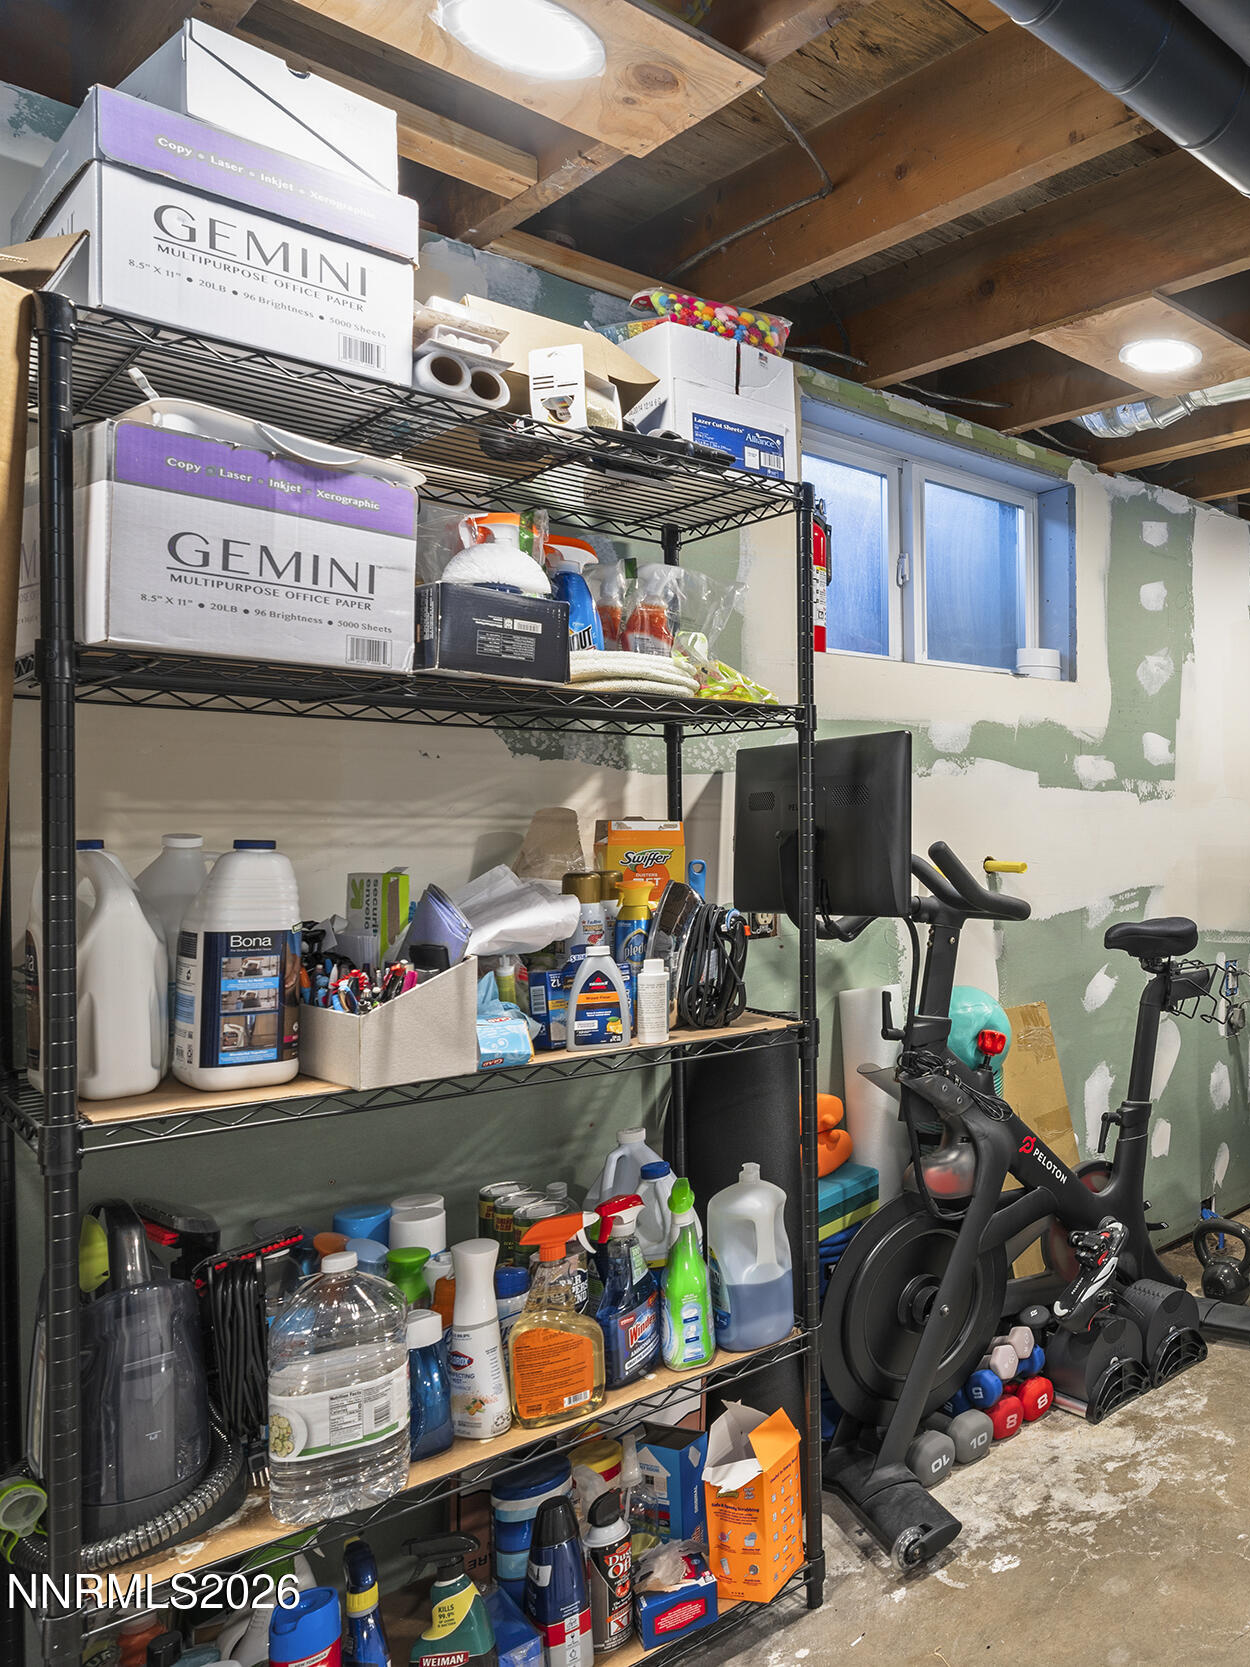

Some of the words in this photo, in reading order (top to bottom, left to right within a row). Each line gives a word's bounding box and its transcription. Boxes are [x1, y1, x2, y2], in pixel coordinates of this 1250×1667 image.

[158, 137, 193, 157] Copy
[210, 156, 244, 174] Laser
[260, 173, 294, 193] Inkjet
[309, 189, 377, 219] Xerographic
[153, 204, 367, 297] GEMINI
[157, 243, 269, 284] MULTIPURPOSE
[274, 278, 320, 299] OFFICE
[326, 294, 364, 312] PAPER
[199, 279, 227, 293] 20LB
[243, 291, 256, 301] 96
[258, 295, 315, 319] Brightness
[329, 316, 352, 329] 5000
[354, 323, 387, 339] Sheets
[694, 416, 712, 426] Lazer
[711, 420, 723, 429] Cut
[745, 433, 775, 448] Alliance
[166, 456, 201, 474] Copy
[219, 467, 252, 483] Laser
[268, 478, 302, 494] Inkjet
[316, 488, 381, 511] Xerographic
[167, 531, 376, 595] GEMINI
[169, 573, 280, 598] MULTIPURPOSE
[285, 589, 331, 605] OFFICE
[335, 598, 372, 611] PAPER
[210, 602, 238, 613] 20LB
[253, 608, 268, 617] 96
[269, 609, 323, 625] Brightness
[337, 619, 359, 629] 5000
[361, 622, 393, 633] Sheets
[570, 626, 593, 651] OUT
[619, 850, 672, 869] Swiffer
[363, 878, 372, 930] envelo
[230, 935, 272, 948] Bona
[624, 943, 648, 960] pled
[550, 977, 562, 988] 12
[1033, 1148, 1068, 1184] PELOTON
[1036, 1393, 1049, 1410] 8
[1006, 1413, 1018, 1430] 8
[969, 1431, 988, 1450] 10
[931, 1453, 951, 1474] 10
[437, 1603, 455, 1613] KILLS
[422, 1653, 465, 1667] WEIMAN
